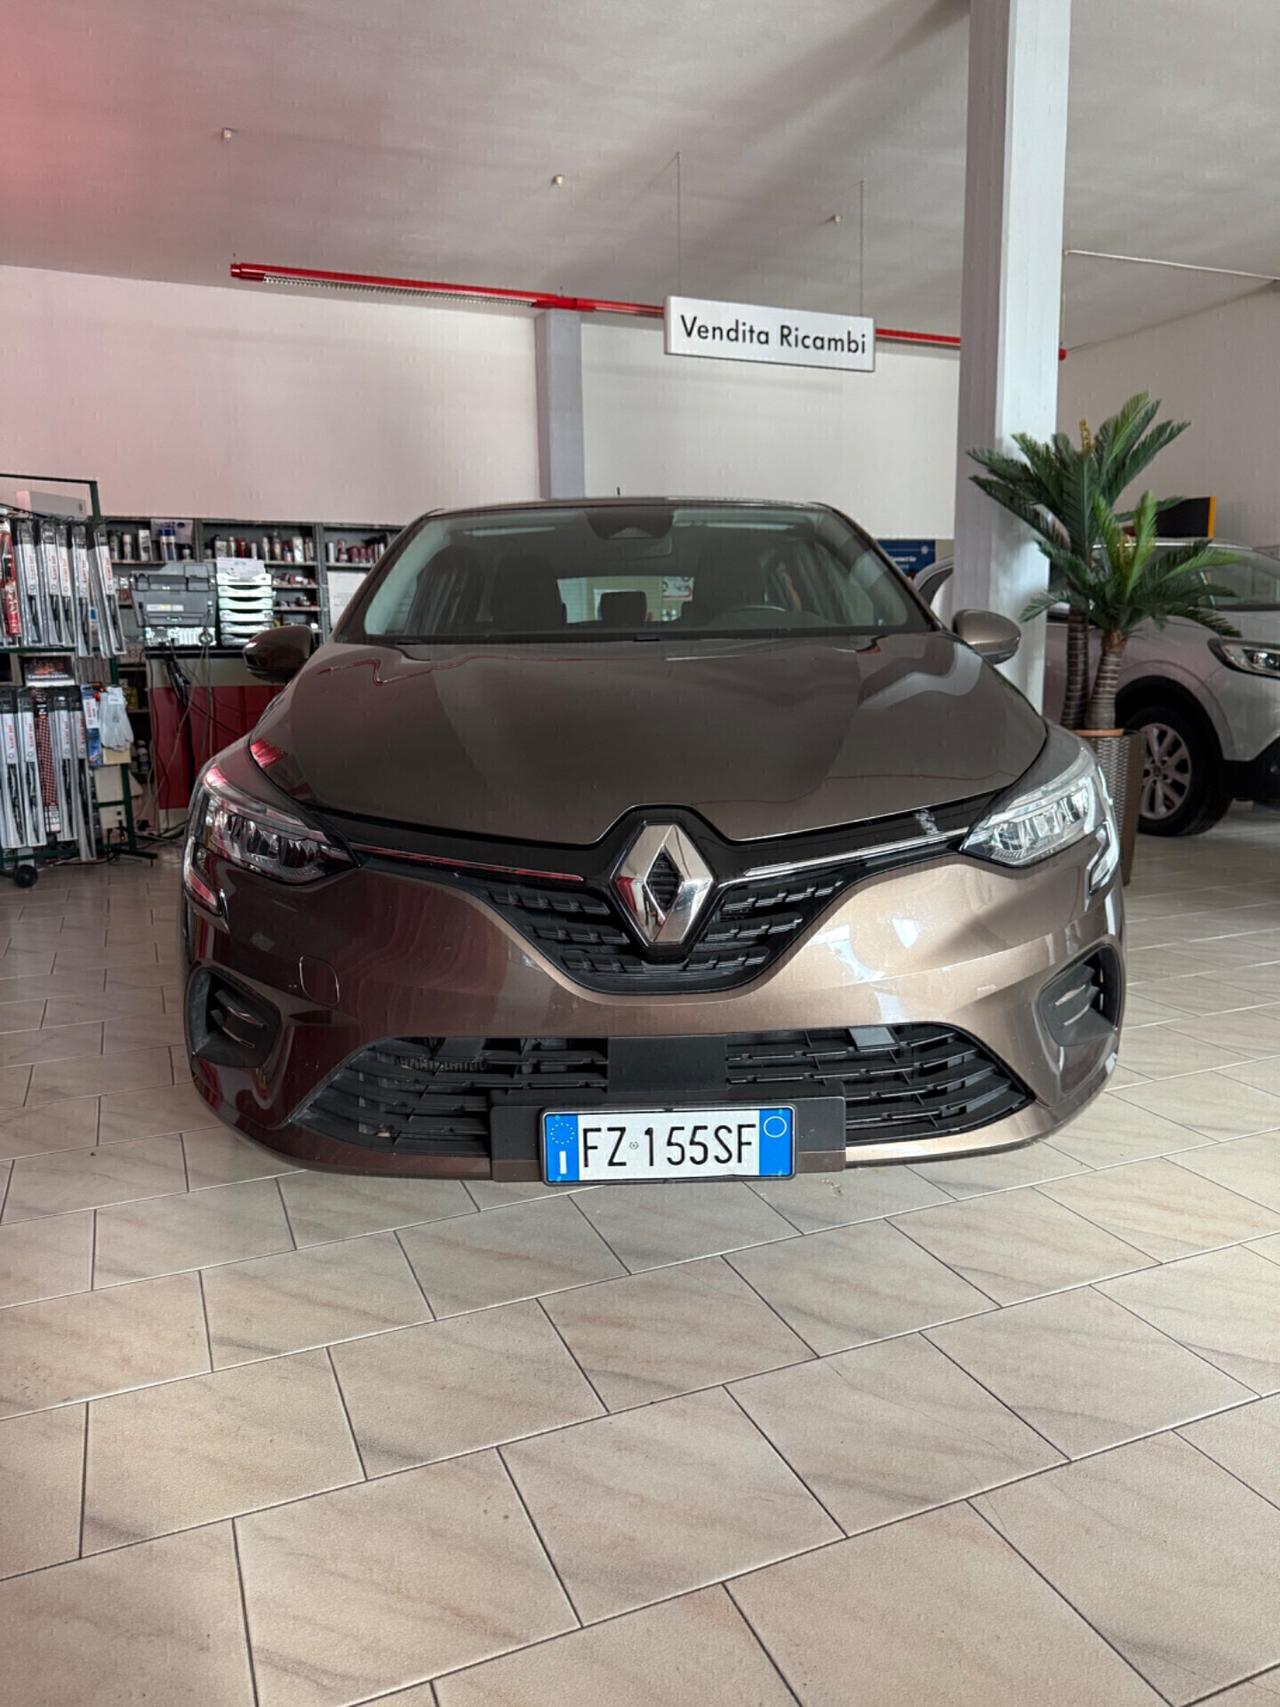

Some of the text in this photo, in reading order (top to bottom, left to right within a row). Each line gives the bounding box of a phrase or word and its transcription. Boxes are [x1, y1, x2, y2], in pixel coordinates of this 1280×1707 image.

[681, 315, 866, 354] Vendita Ricambi
[559, 1151, 567, 1174] I
[583, 1124, 756, 1168] FZ 155SF
